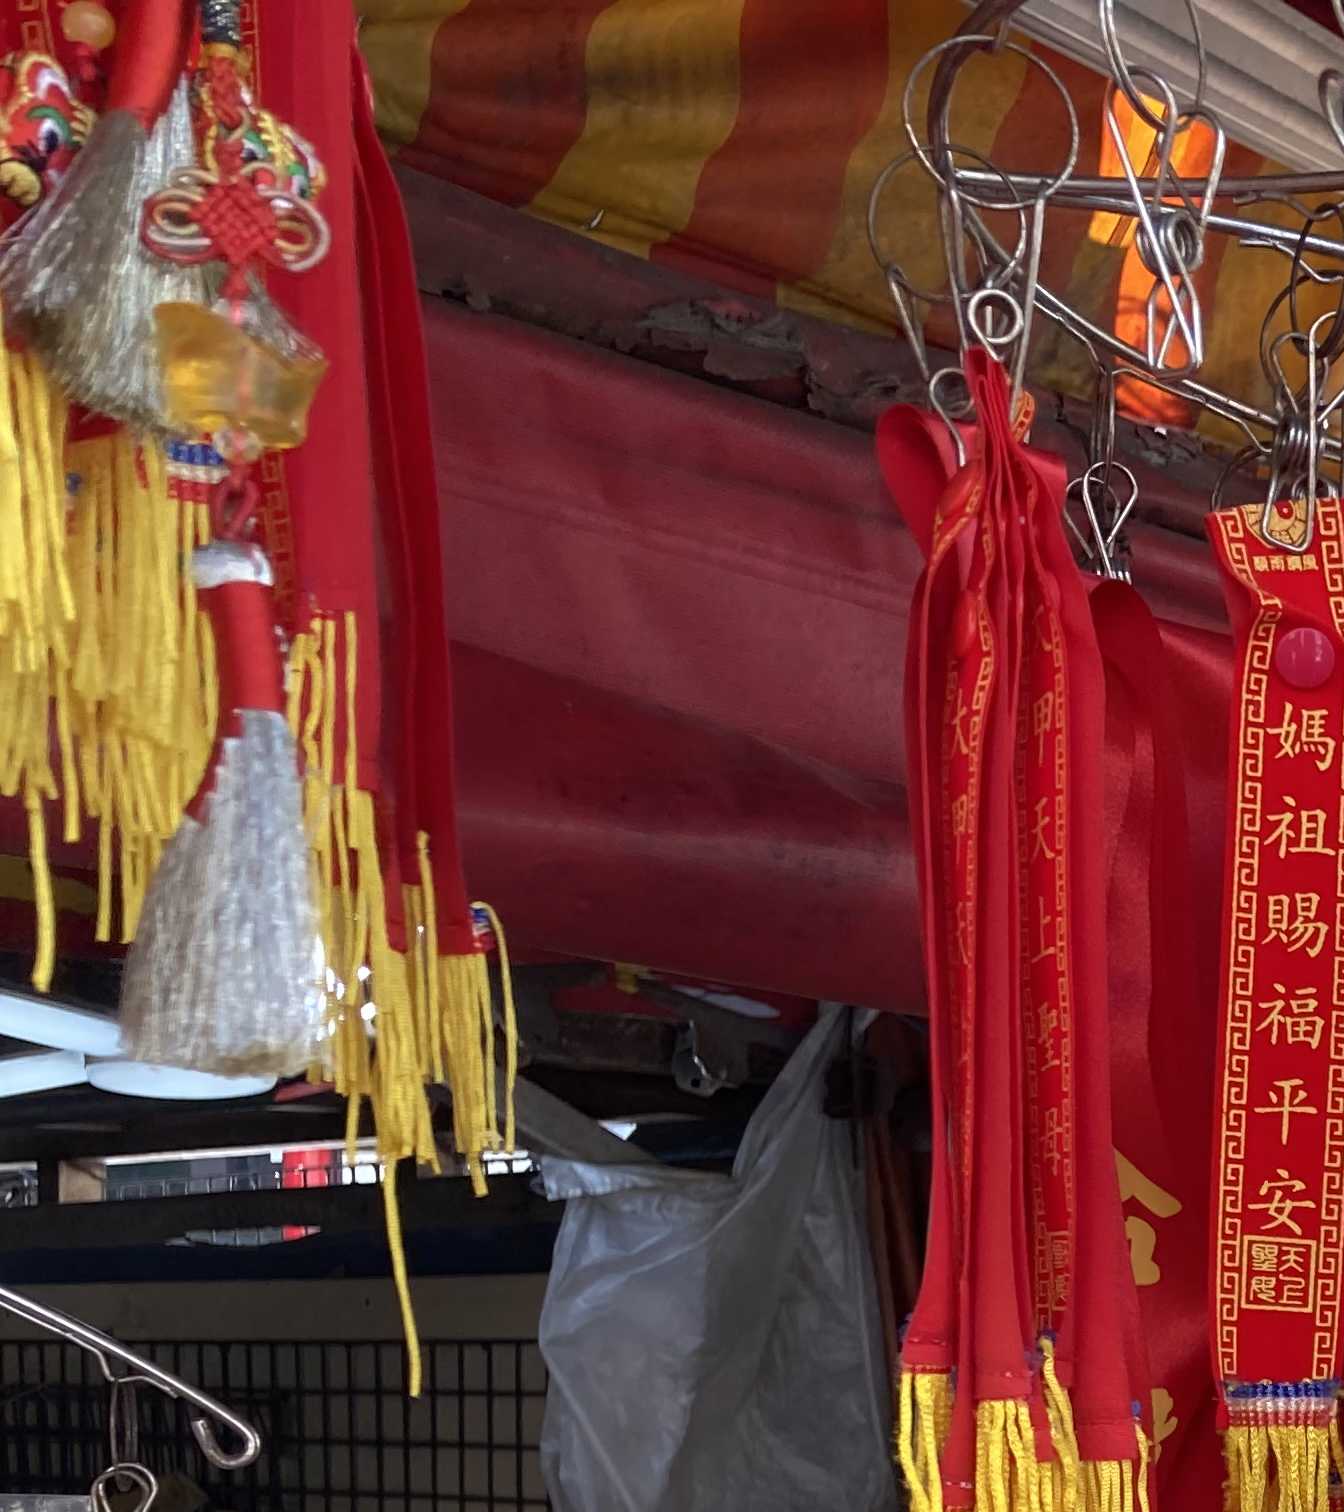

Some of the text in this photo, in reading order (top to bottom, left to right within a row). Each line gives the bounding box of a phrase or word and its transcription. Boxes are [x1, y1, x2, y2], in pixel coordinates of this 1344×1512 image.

[1248, 700, 1336, 1236] 媽祖賜福平安
